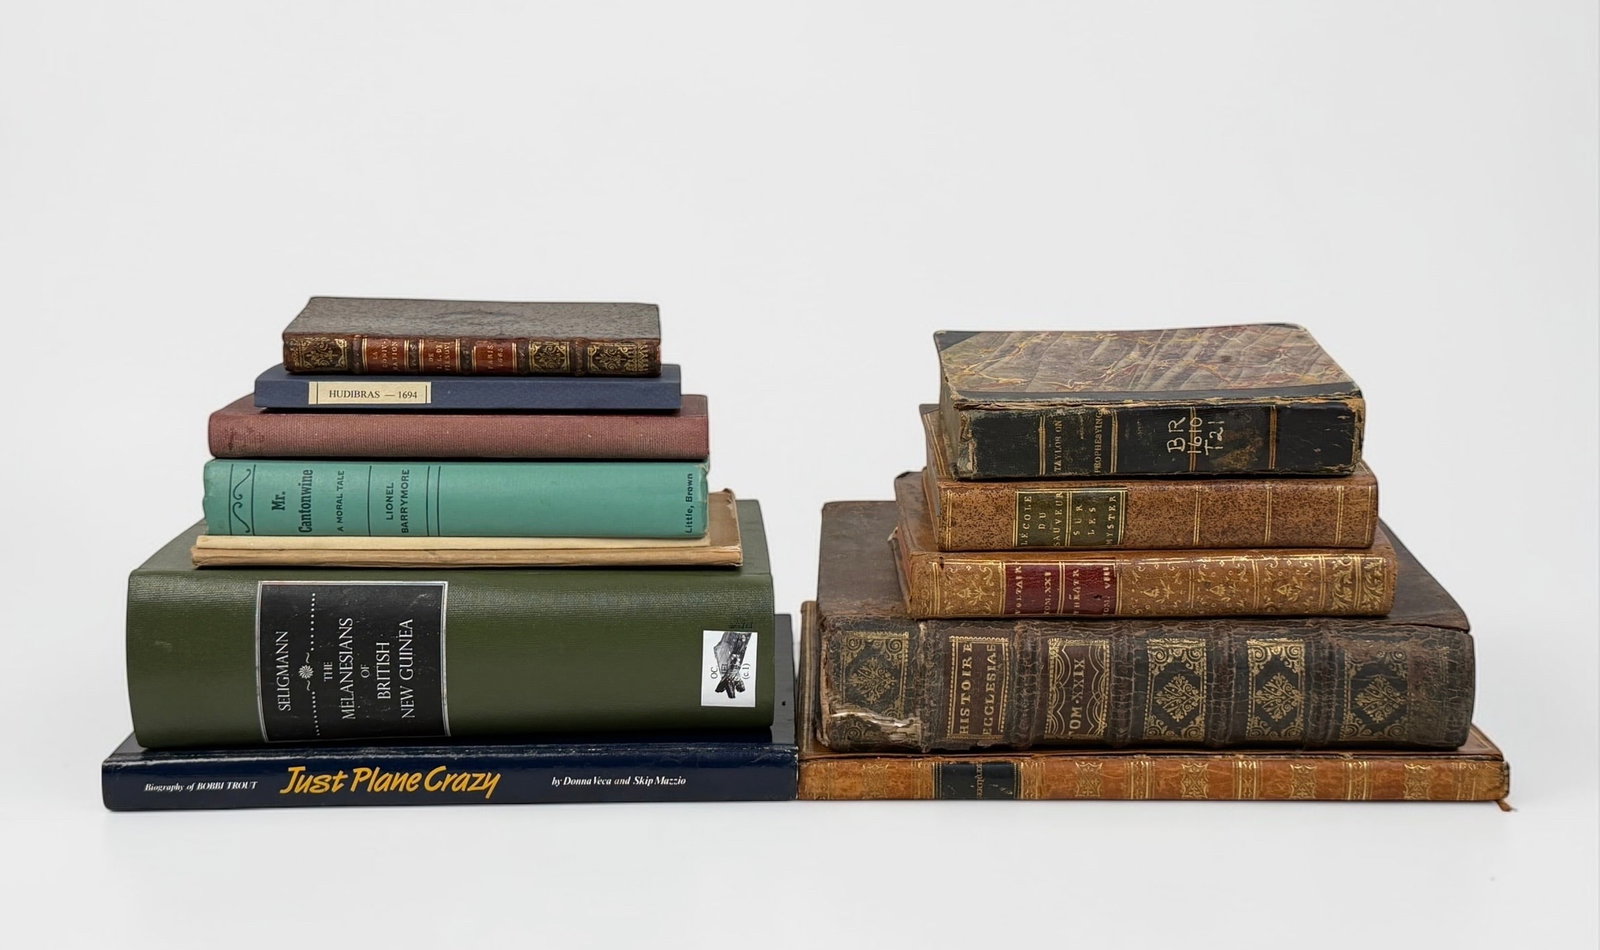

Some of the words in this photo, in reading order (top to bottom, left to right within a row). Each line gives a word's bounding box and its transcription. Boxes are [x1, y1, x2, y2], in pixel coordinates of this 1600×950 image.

[328, 390, 380, 399] HUDIBRAS
[398, 391, 418, 399] 1694
[1054, 420, 1063, 433] ON
[1093, 412, 1103, 473] PROPHESYING
[1166, 416, 1187, 454] BR
[1187, 416, 1203, 454] 1610
[1203, 420, 1225, 456] T21
[1053, 436, 1063, 472] TAYLOR
[336, 470, 345, 491] TALE
[685, 473, 694, 503] Brown
[271, 491, 286, 511] Mr.
[298, 469, 313, 533] Cantonwine
[336, 494, 345, 523] MORAL
[385, 482, 394, 521] LIONEL
[400, 469, 410, 534] BARRYMORE
[685, 505, 695, 534] Little,
[1038, 512, 1047, 530] DU
[1053, 492, 1064, 547] SAUVEUR
[1073, 504, 1083, 536] SUR
[1088, 507, 1097, 535] LES
[1106, 496, 1117, 546] MYSTER
[398, 619, 414, 681] GUINEA
[275, 631, 291, 711] SELIGMANN
[323, 661, 333, 682] THE
[338, 617, 356, 720] MELANESIANS
[360, 664, 371, 679] OF
[376, 642, 391, 700] BRITISH
[710, 666, 719, 680] OC
[399, 685, 415, 719] NEW
[959, 642, 973, 735] HISTOIRE
[144, 783, 184, 792] Biography
[186, 782, 195, 791] of
[196, 782, 224, 791] BOBBI
[225, 781, 258, 790] TROUT
[280, 765, 349, 794] Just
[350, 766, 422, 793] Plane
[424, 765, 502, 799] Crazy
[551, 776, 562, 788] by
[563, 776, 592, 786] Donna
[593, 776, 612, 785] Veca
[613, 776, 631, 785] and
[632, 775, 653, 787] Skip
[654, 775, 687, 786] Mazzio
